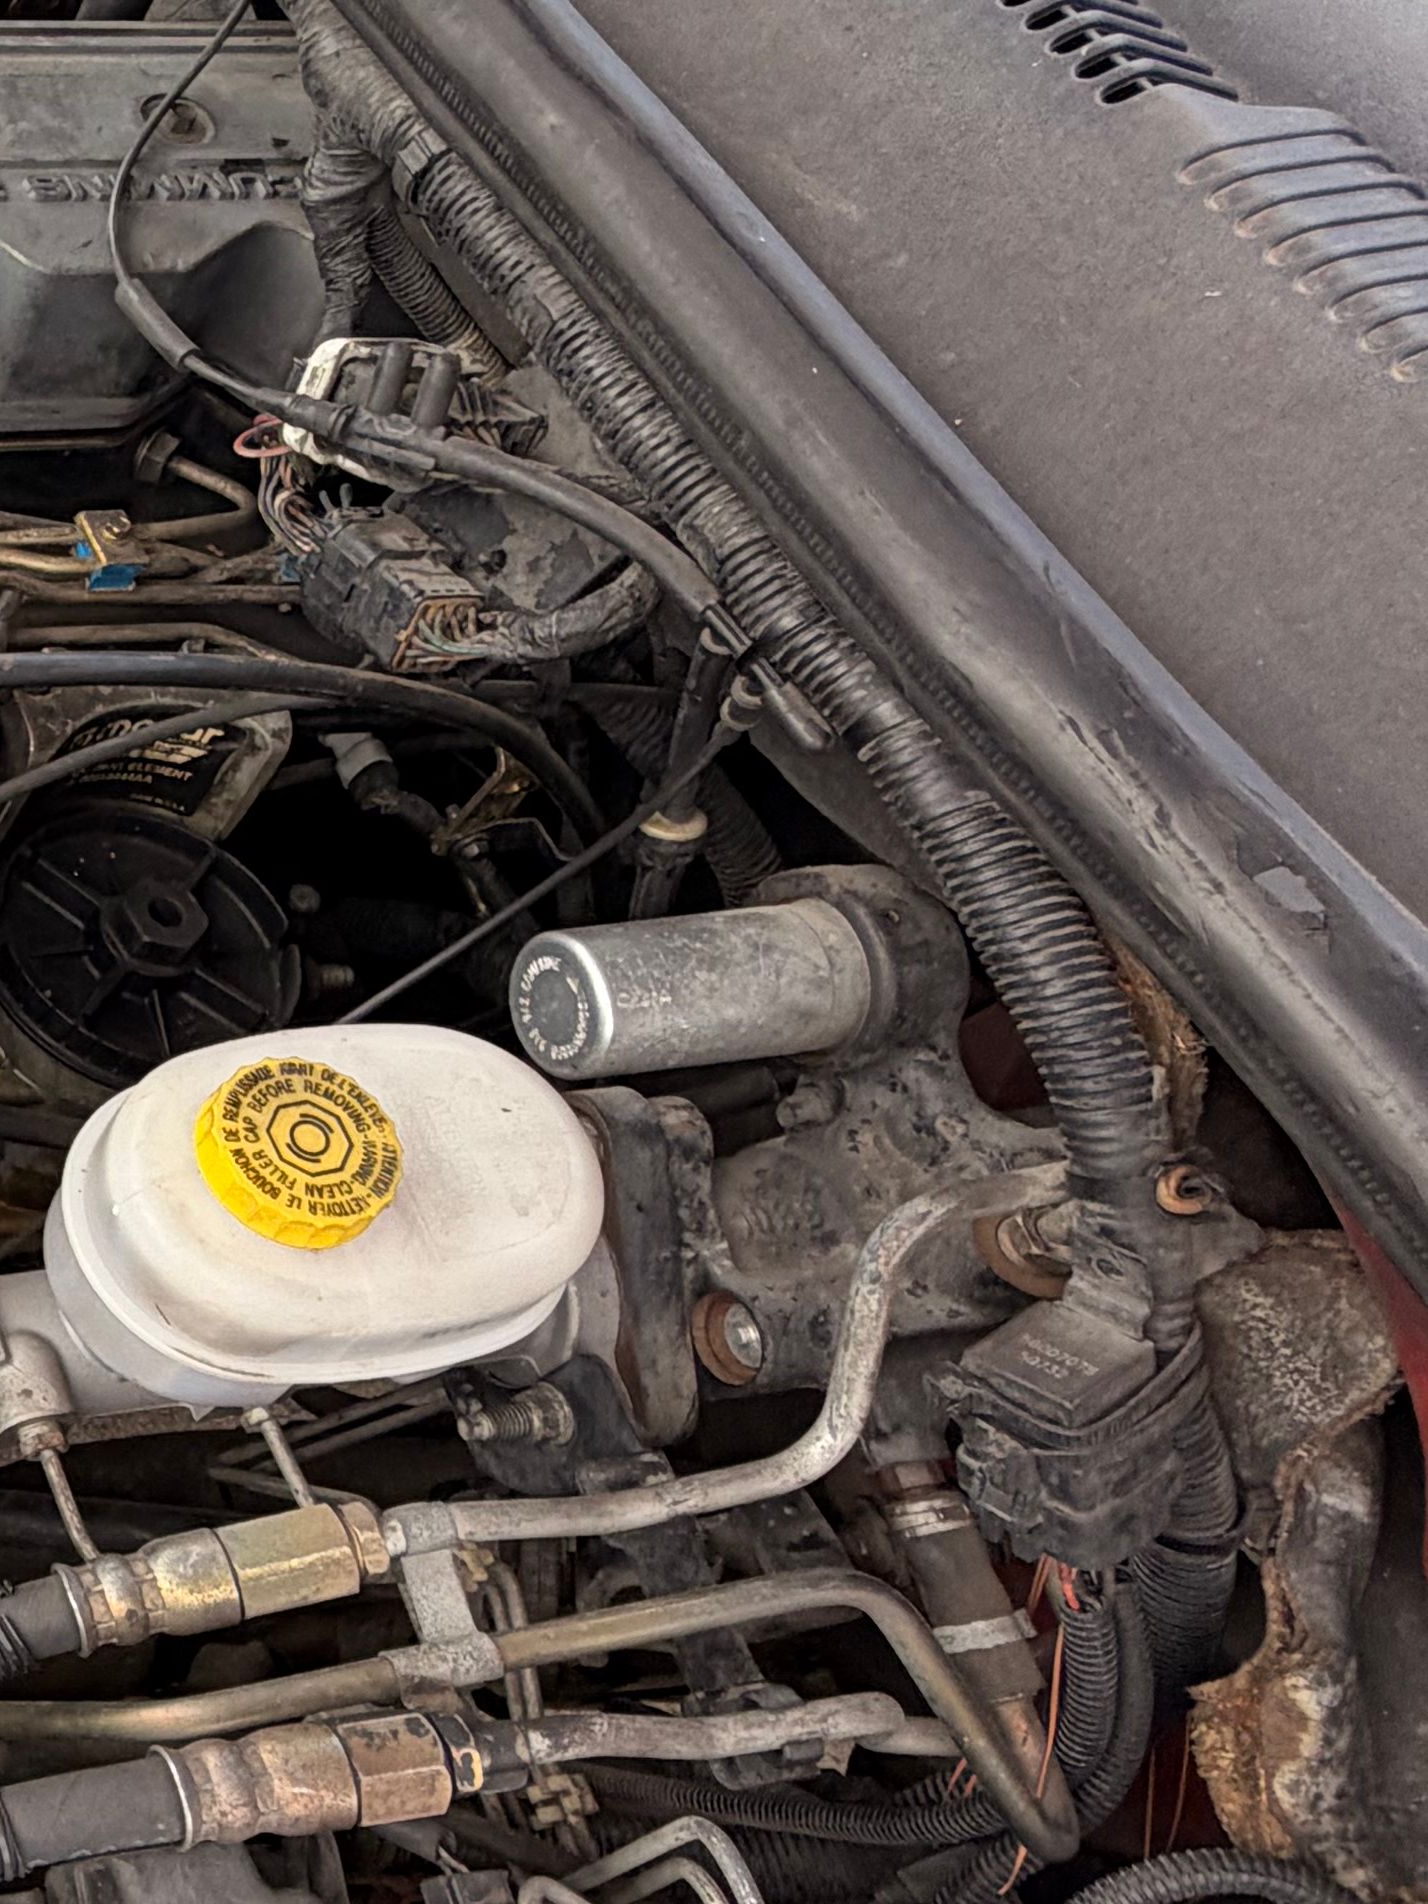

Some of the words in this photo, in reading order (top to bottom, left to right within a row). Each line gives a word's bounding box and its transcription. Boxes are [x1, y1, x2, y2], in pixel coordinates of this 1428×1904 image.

[320, 1068, 337, 1082] DE
[246, 1078, 296, 1114] BEFORE
[222, 1126, 241, 1143] DE
[242, 1116, 261, 1144] CAP
[229, 1148, 281, 1200] BOUCHON
[252, 1149, 297, 1191] FILLER
[285, 1194, 303, 1210] LE
